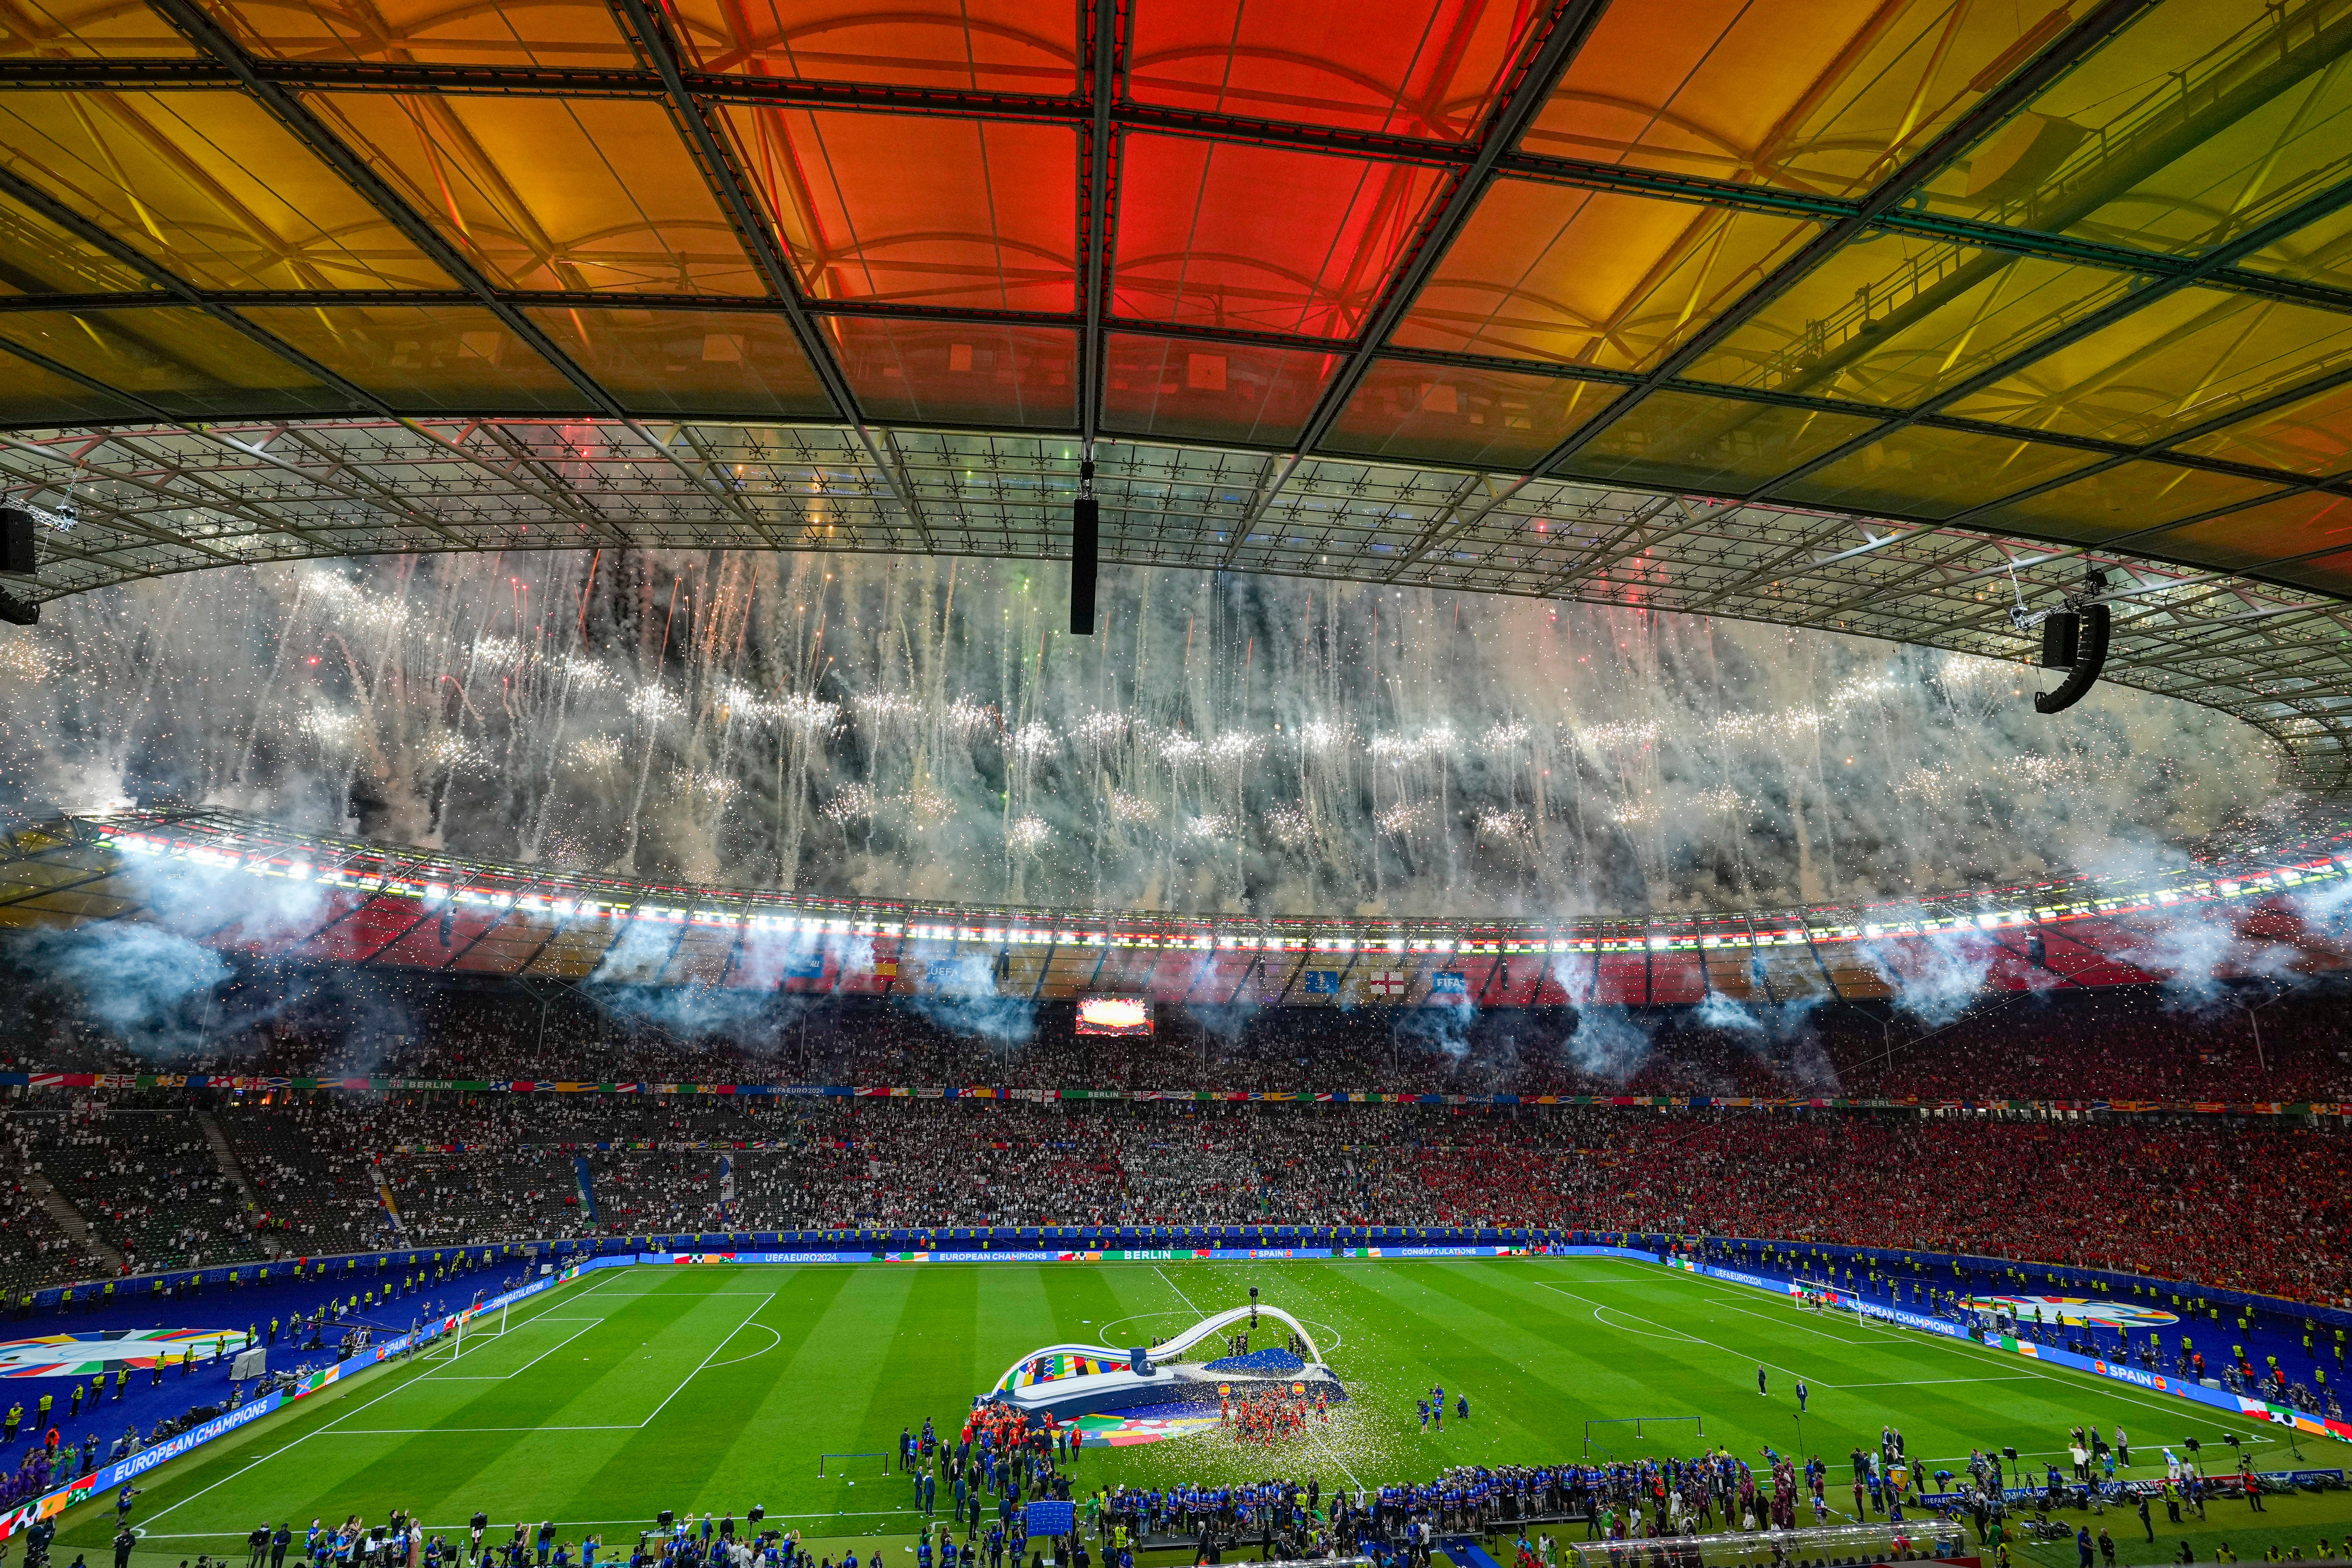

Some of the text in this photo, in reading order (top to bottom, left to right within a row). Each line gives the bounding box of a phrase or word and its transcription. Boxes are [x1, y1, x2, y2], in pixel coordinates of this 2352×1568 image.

[931, 967, 958, 976] UEFA
[1437, 978, 1461, 987] FIFA
[1124, 1250, 1171, 1259] BERLIN
[1715, 1269, 1762, 1286] UEFAEURO2024
[1847, 1300, 1955, 1335] EUROPEAN CHAMPIONS
[384, 1337, 407, 1356] SPAIN
[2110, 1365, 2151, 1386] SPAIN
[113, 1400, 267, 1482] EUROPEAN CHAMPIONS
